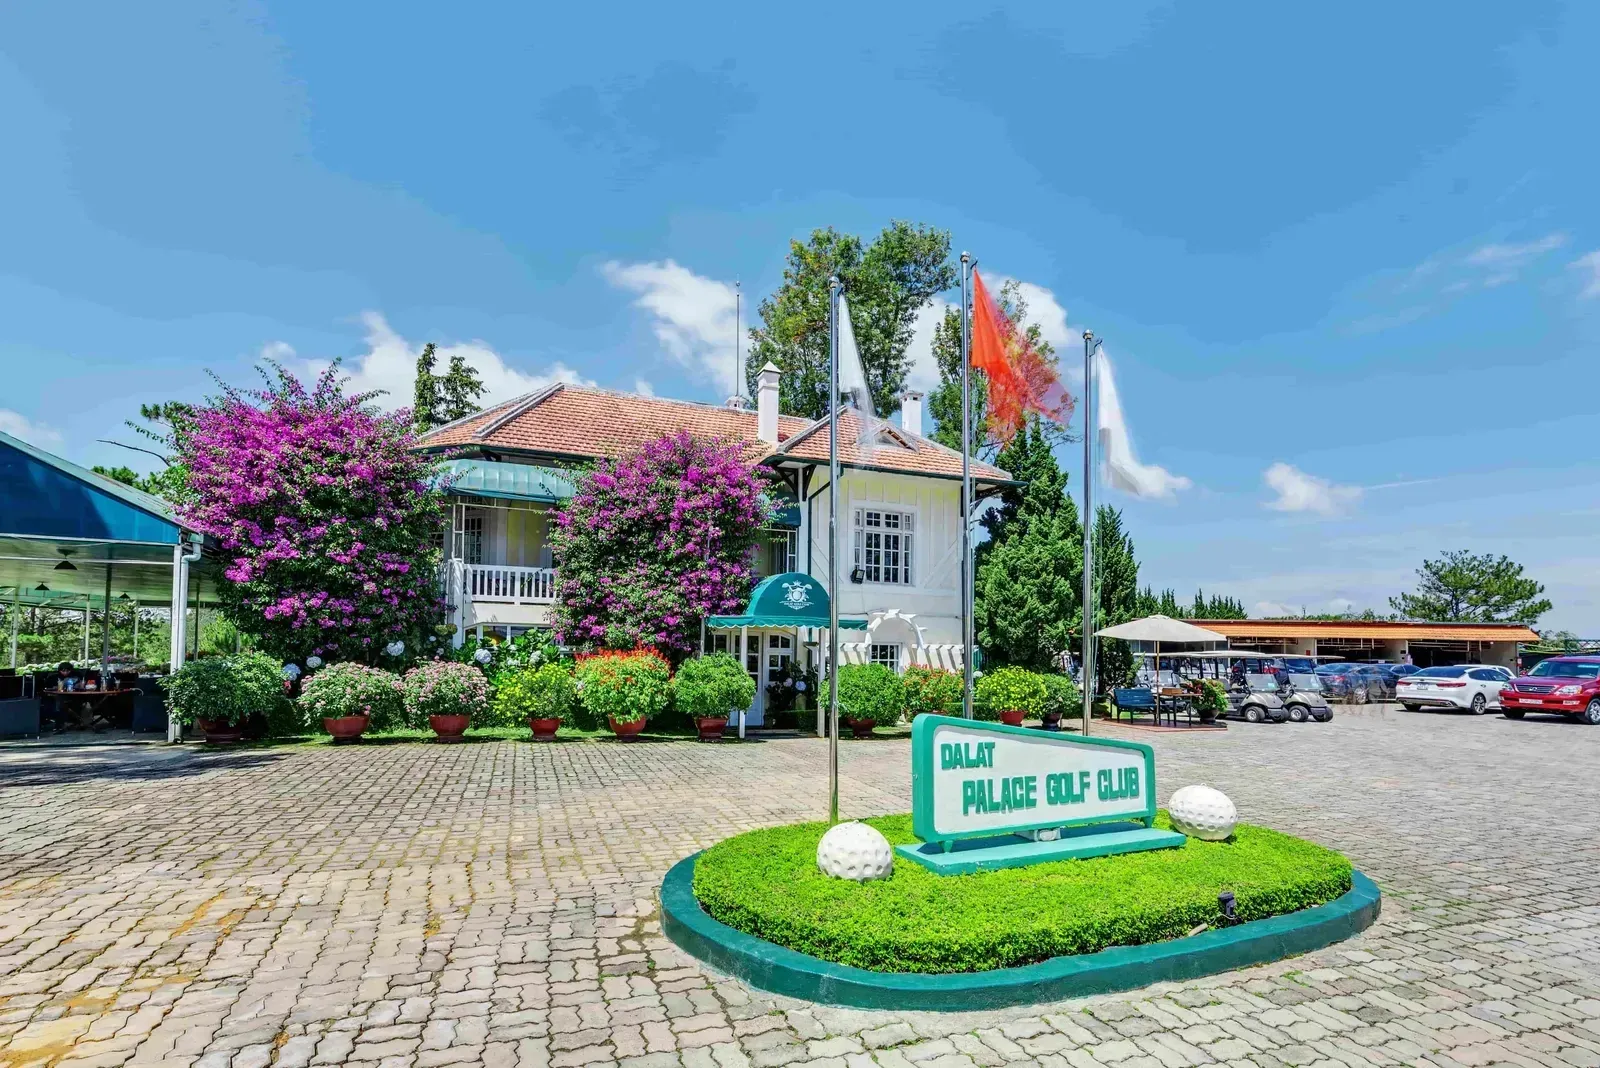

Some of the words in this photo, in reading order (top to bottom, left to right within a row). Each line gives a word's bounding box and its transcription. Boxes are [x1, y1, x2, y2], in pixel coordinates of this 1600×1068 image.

[941, 743, 995, 770] DALAT
[963, 776, 1037, 815] PALACE
[1046, 771, 1090, 804] GOLF
[1097, 767, 1139, 800] CLUB
